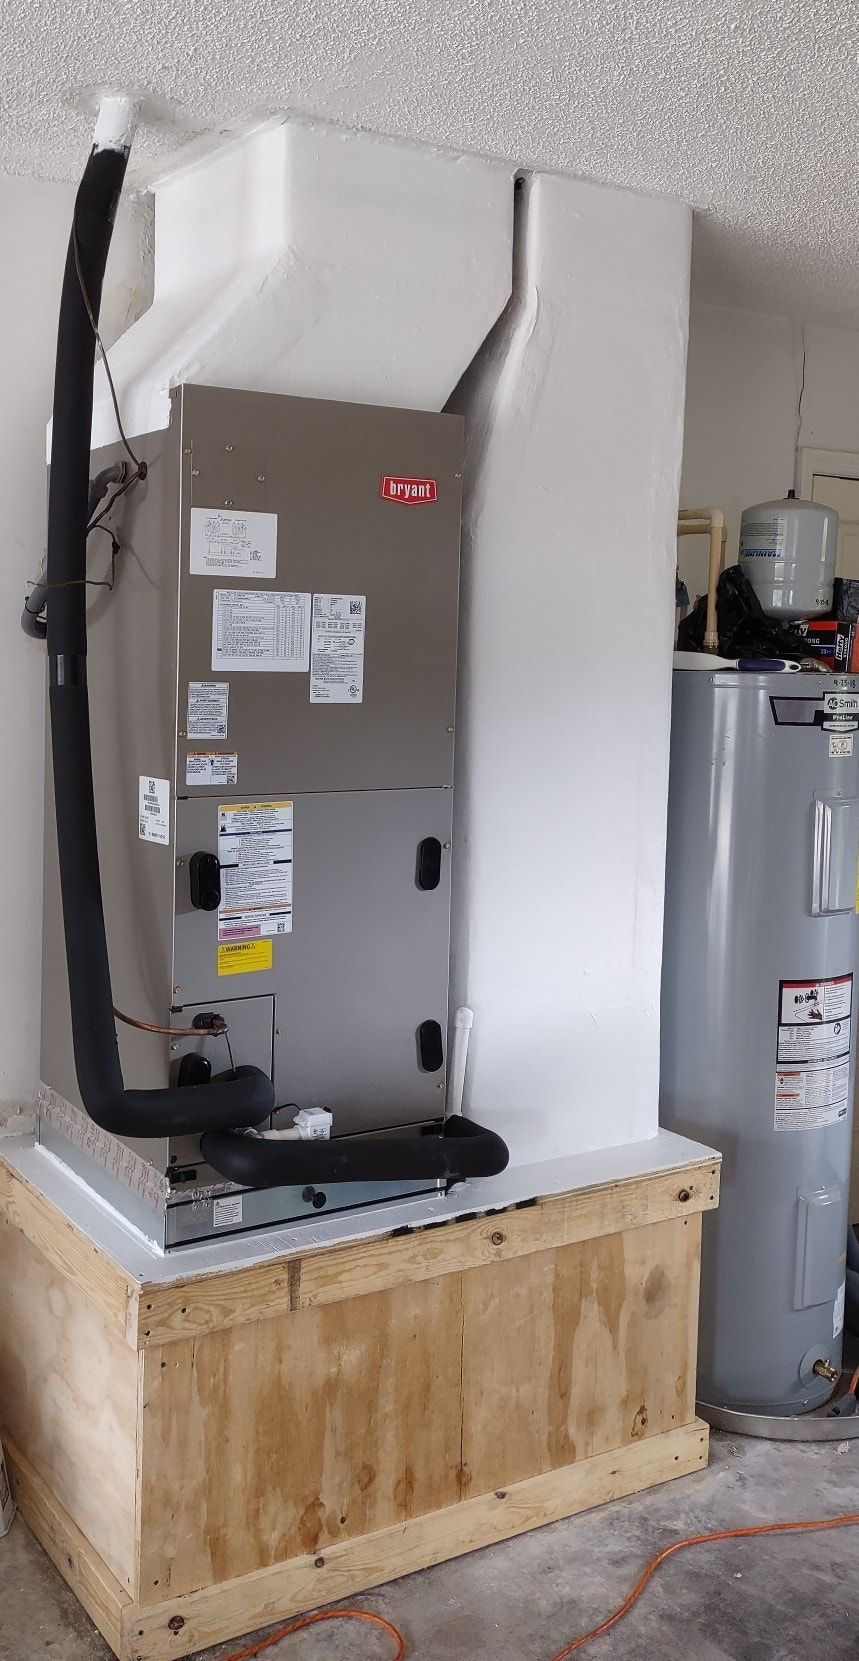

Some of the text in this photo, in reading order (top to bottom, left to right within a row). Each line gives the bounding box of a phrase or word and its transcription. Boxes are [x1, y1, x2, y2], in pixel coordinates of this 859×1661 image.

[389, 480, 431, 499] bryant
[835, 633, 845, 660] Hefty
[839, 699, 858, 708] Smith
[225, 943, 251, 952] WARNING
